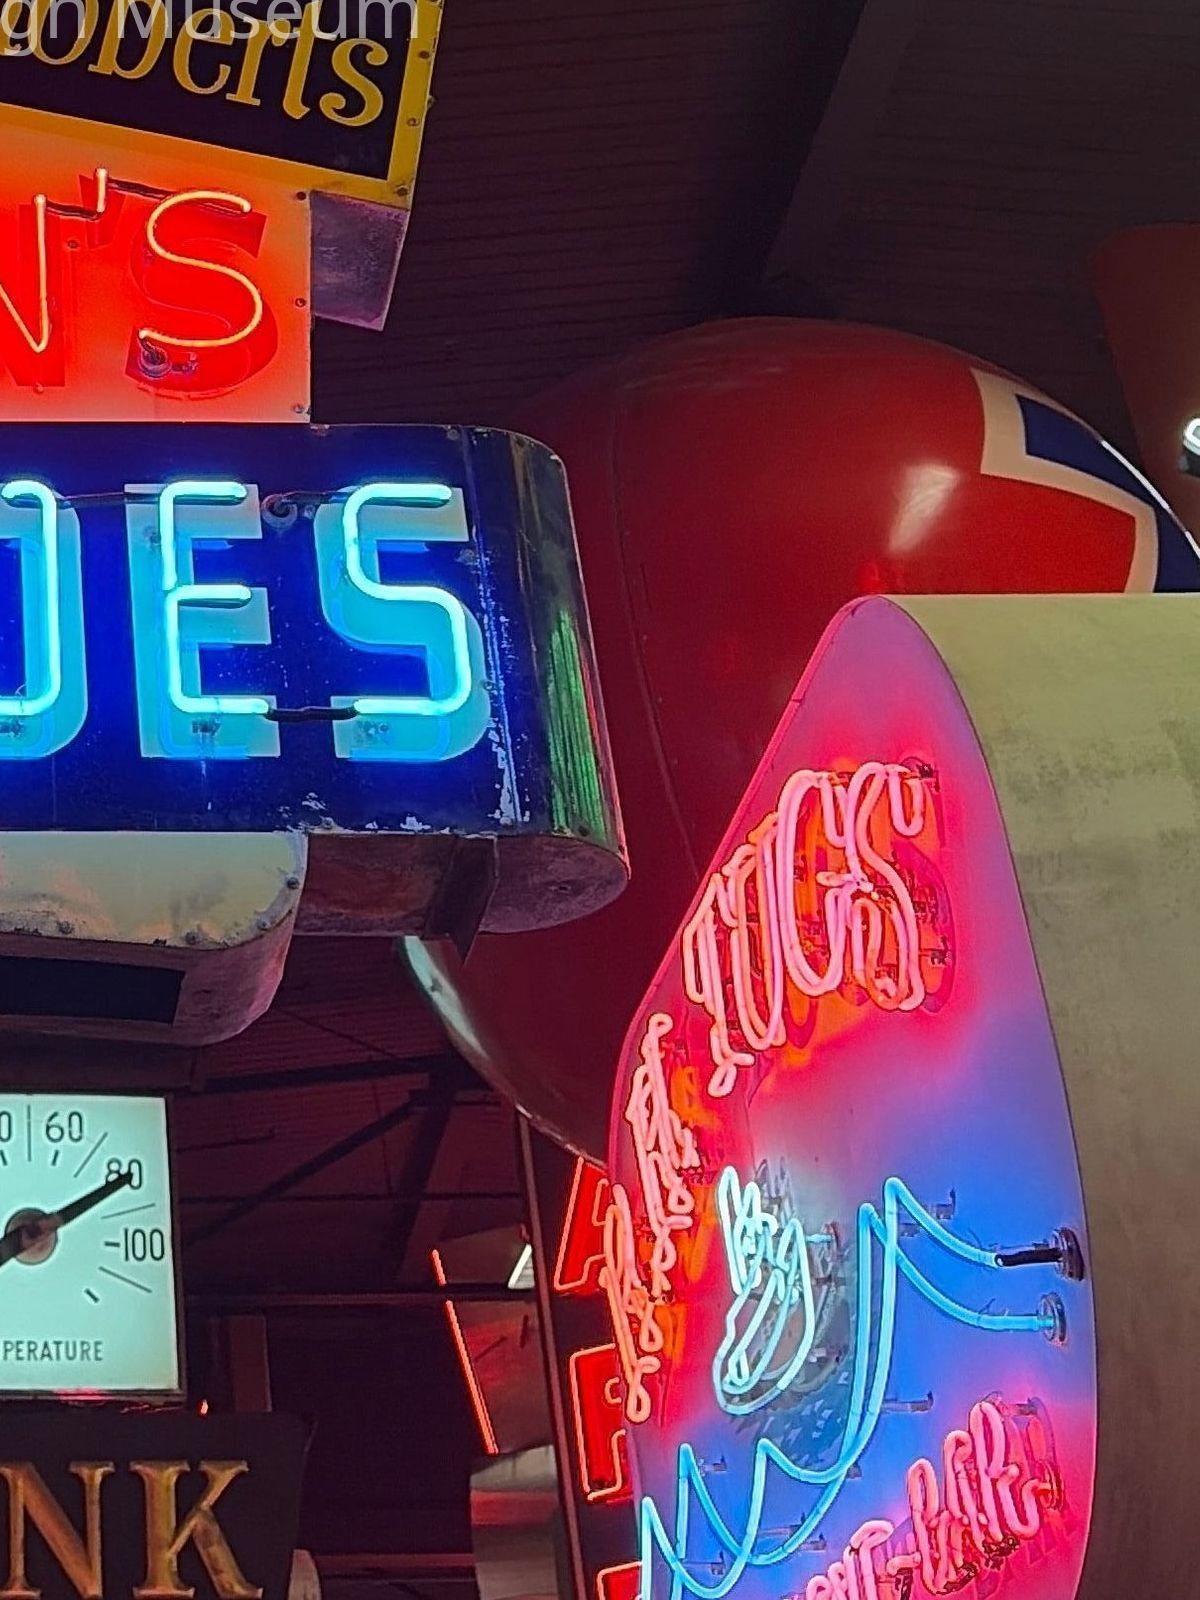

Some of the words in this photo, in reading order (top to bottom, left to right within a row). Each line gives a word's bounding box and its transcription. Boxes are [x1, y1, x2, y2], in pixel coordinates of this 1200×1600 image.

[45, 1110, 84, 1143] 60
[105, 1158, 143, 1190] 80
[122, 1227, 165, 1262] 100
